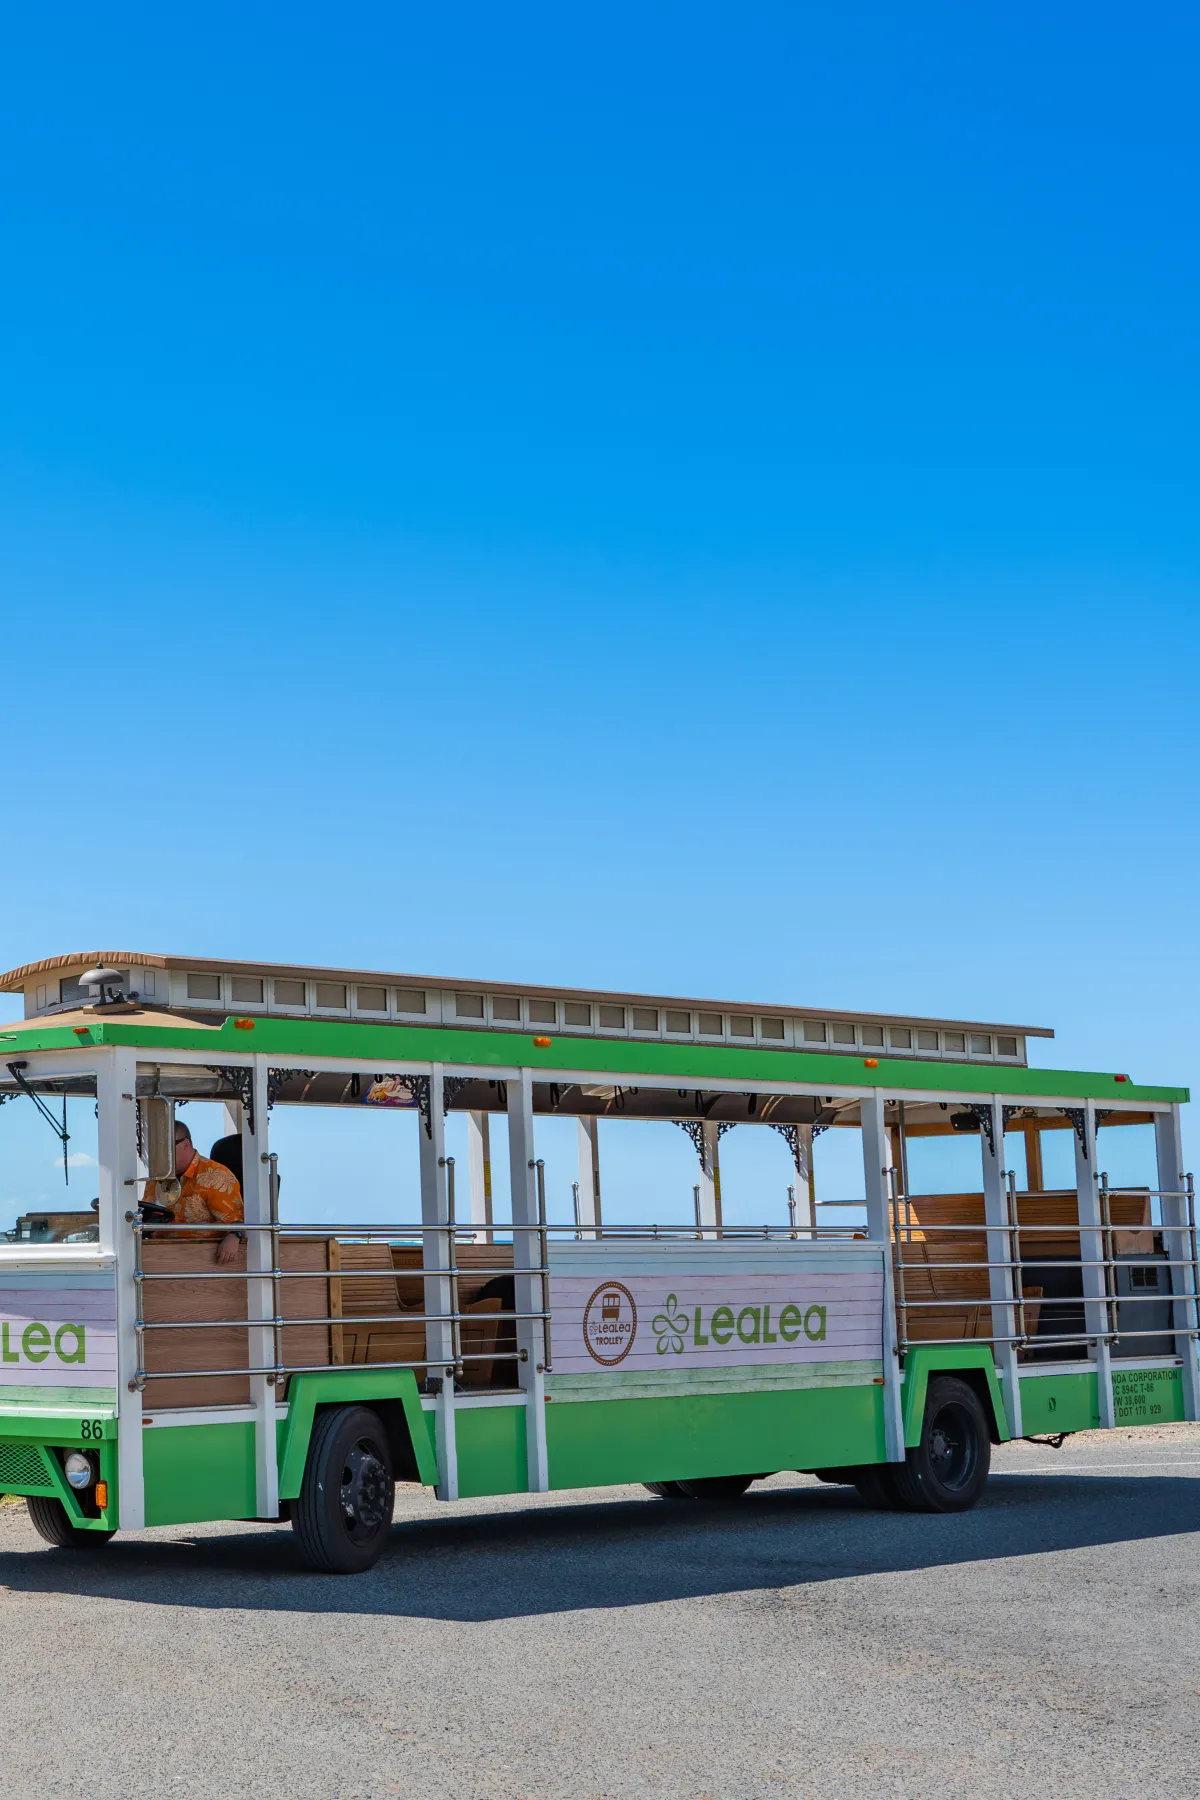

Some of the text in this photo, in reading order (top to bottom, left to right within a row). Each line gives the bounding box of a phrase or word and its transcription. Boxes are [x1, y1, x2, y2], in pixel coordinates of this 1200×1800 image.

[694, 1304, 827, 1346] LeaLea
[596, 1336, 623, 1346] TROLLEY
[1129, 1371, 1178, 1382] CORPORATION
[1119, 1406, 1132, 1417] DOT
[1150, 1405, 1161, 1414] 929
[81, 1419, 103, 1439] 86
